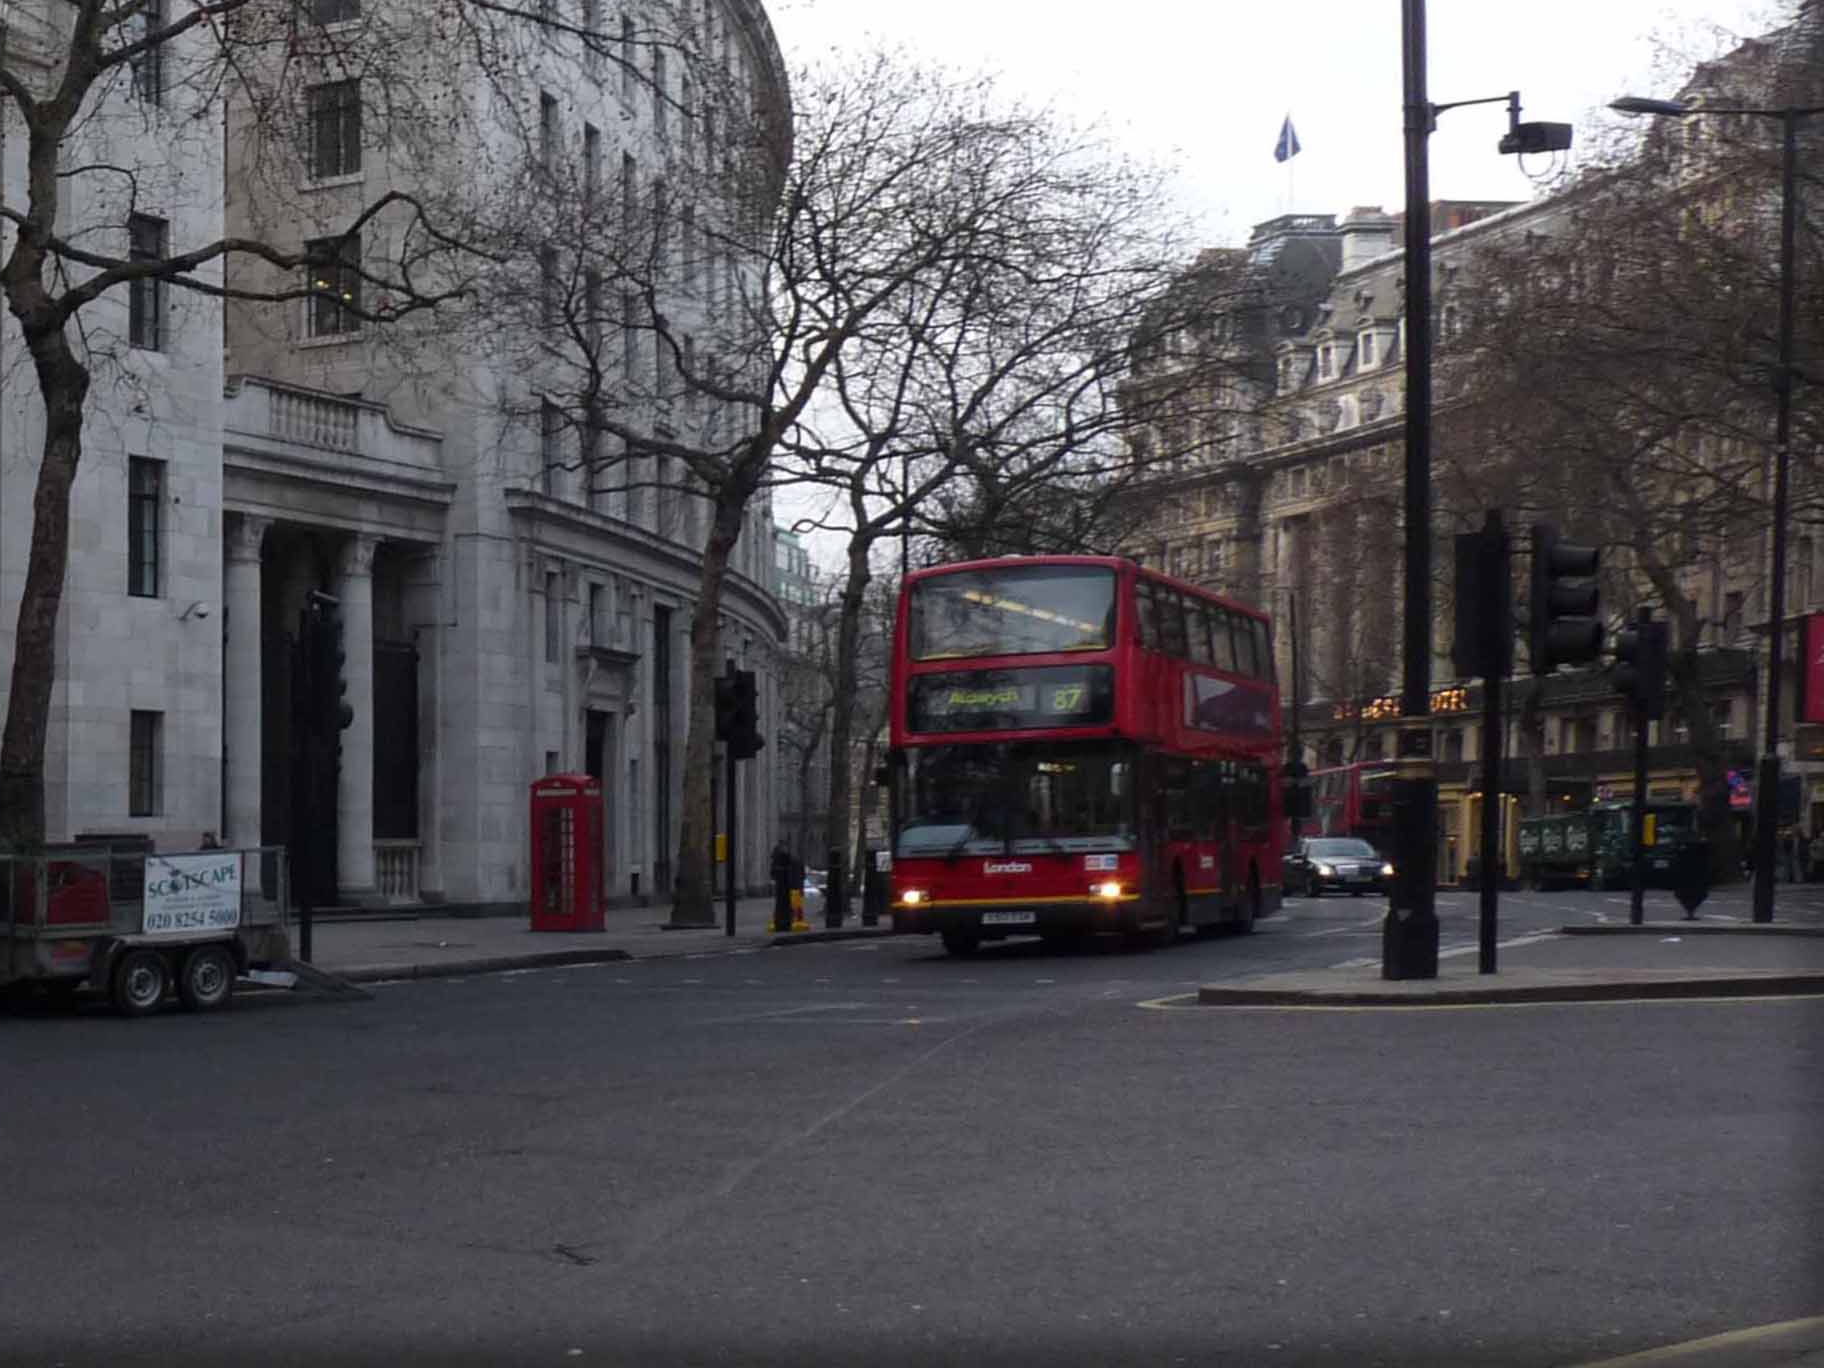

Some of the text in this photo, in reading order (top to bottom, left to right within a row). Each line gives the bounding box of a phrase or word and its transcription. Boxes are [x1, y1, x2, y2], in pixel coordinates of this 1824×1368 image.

[1054, 687, 1082, 711] 87
[983, 861, 1033, 874] London
[147, 908, 238, 929] 020 8254 5000
